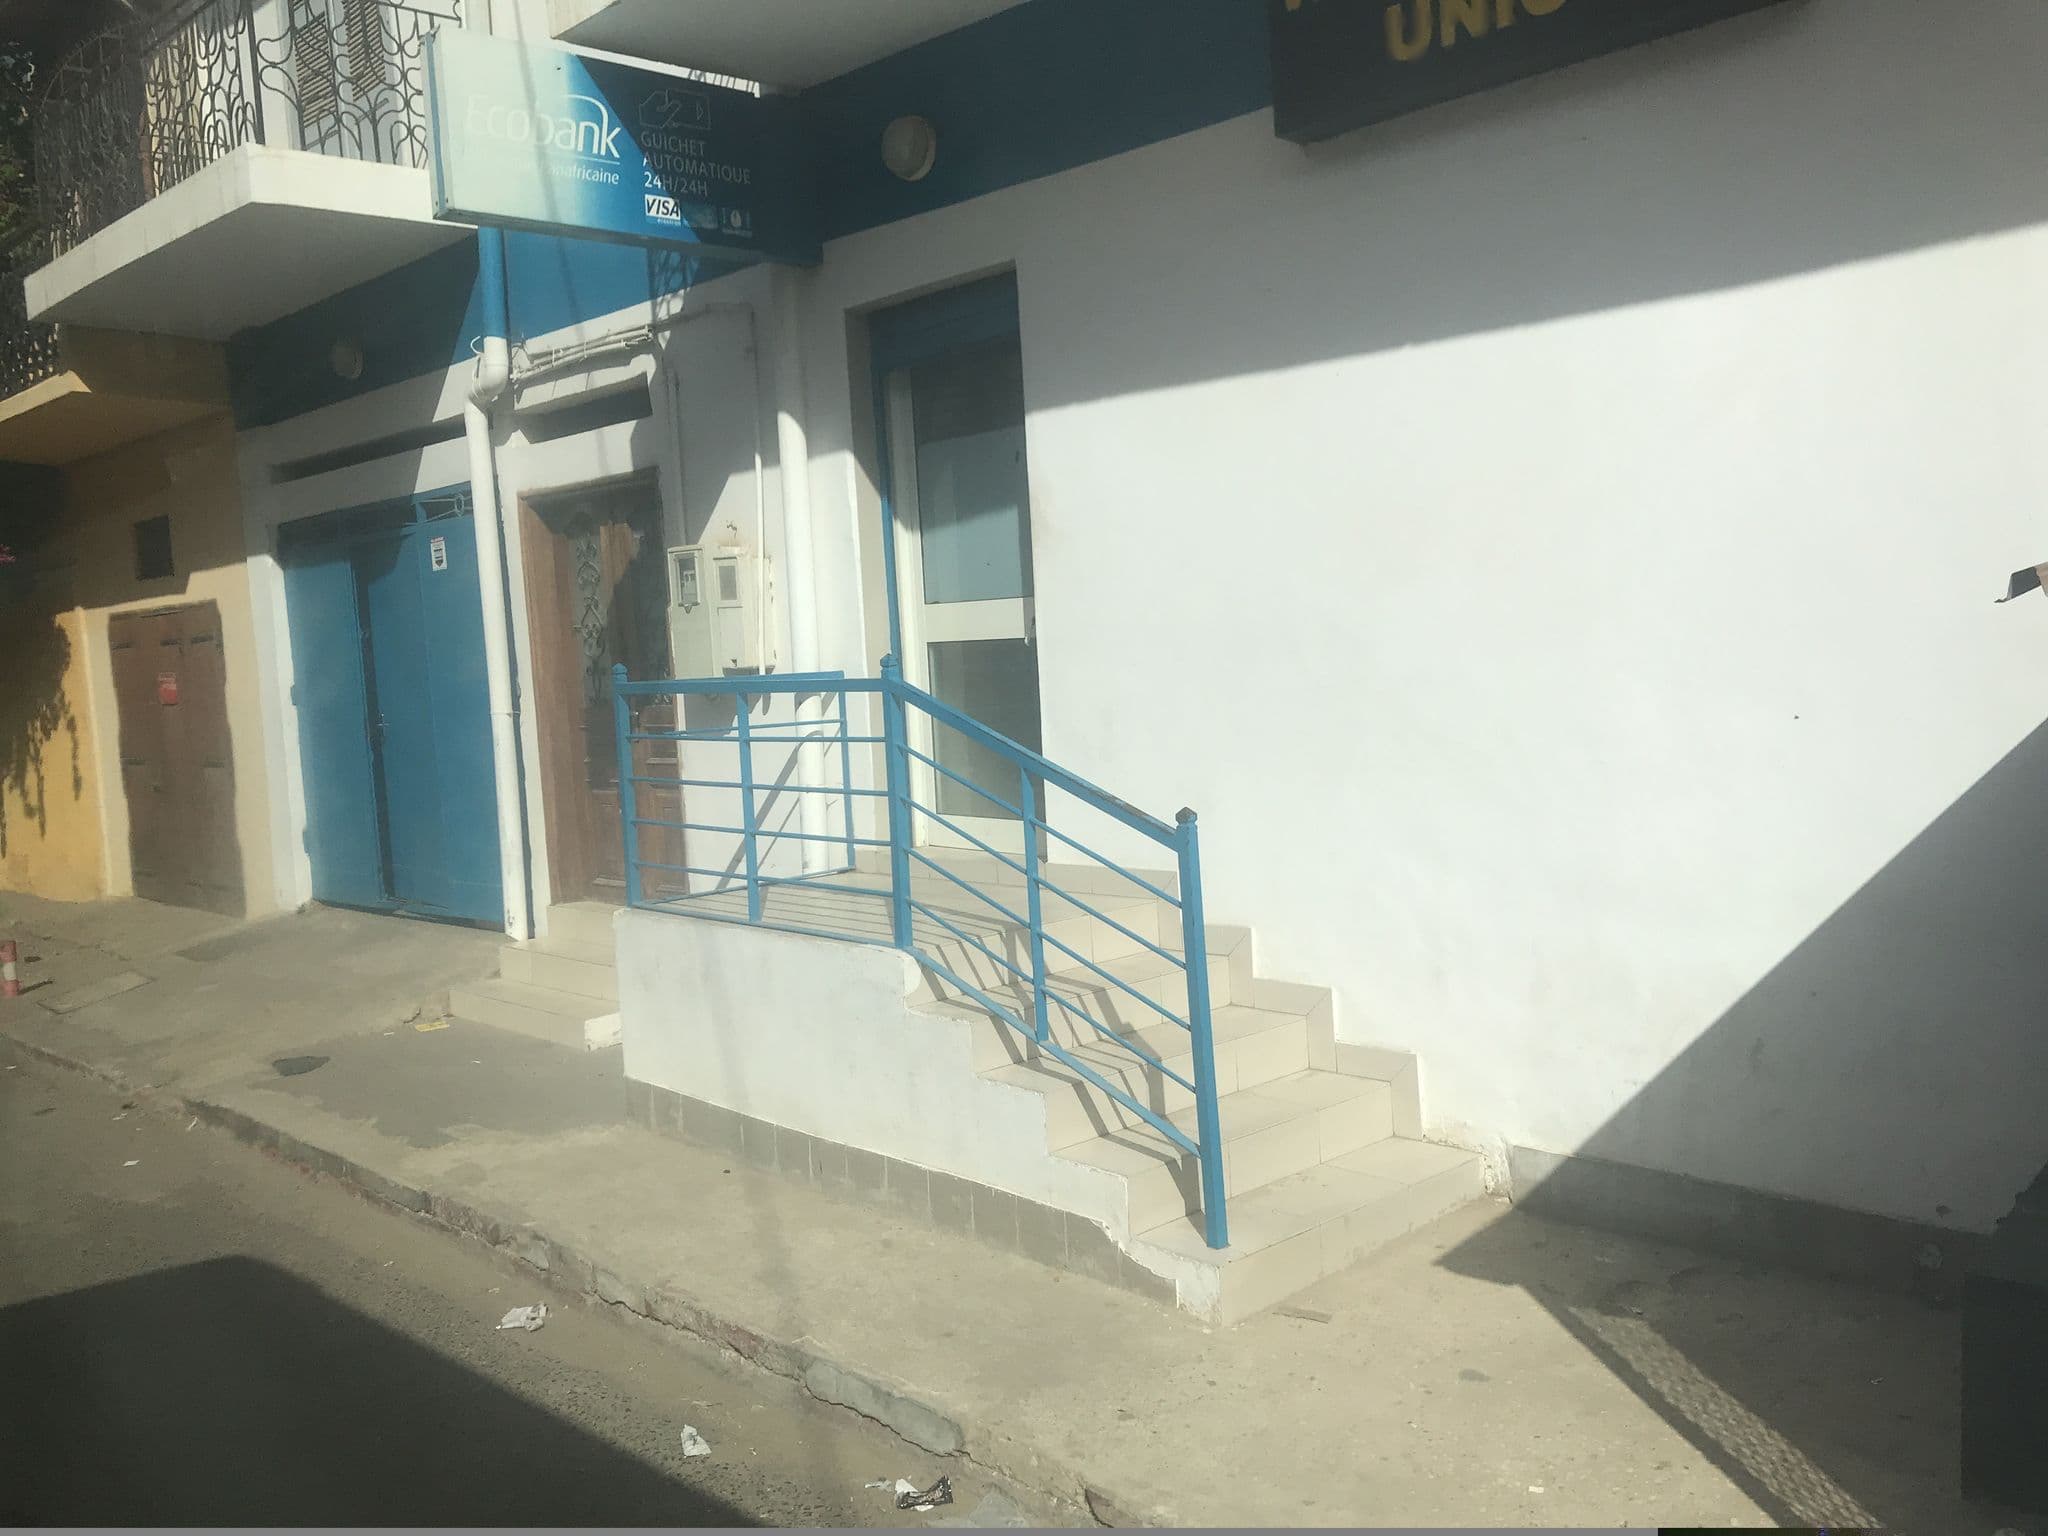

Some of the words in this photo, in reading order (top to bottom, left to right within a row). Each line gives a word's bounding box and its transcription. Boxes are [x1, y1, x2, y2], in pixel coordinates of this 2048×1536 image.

[1384, 0, 1568, 61] UNI
[465, 92, 622, 158] Ecobank
[640, 129, 708, 157] GUICHET
[642, 151, 752, 185] AUTOMATIQUE
[643, 170, 709, 198] 24H/24H
[646, 198, 680, 217] VISA
